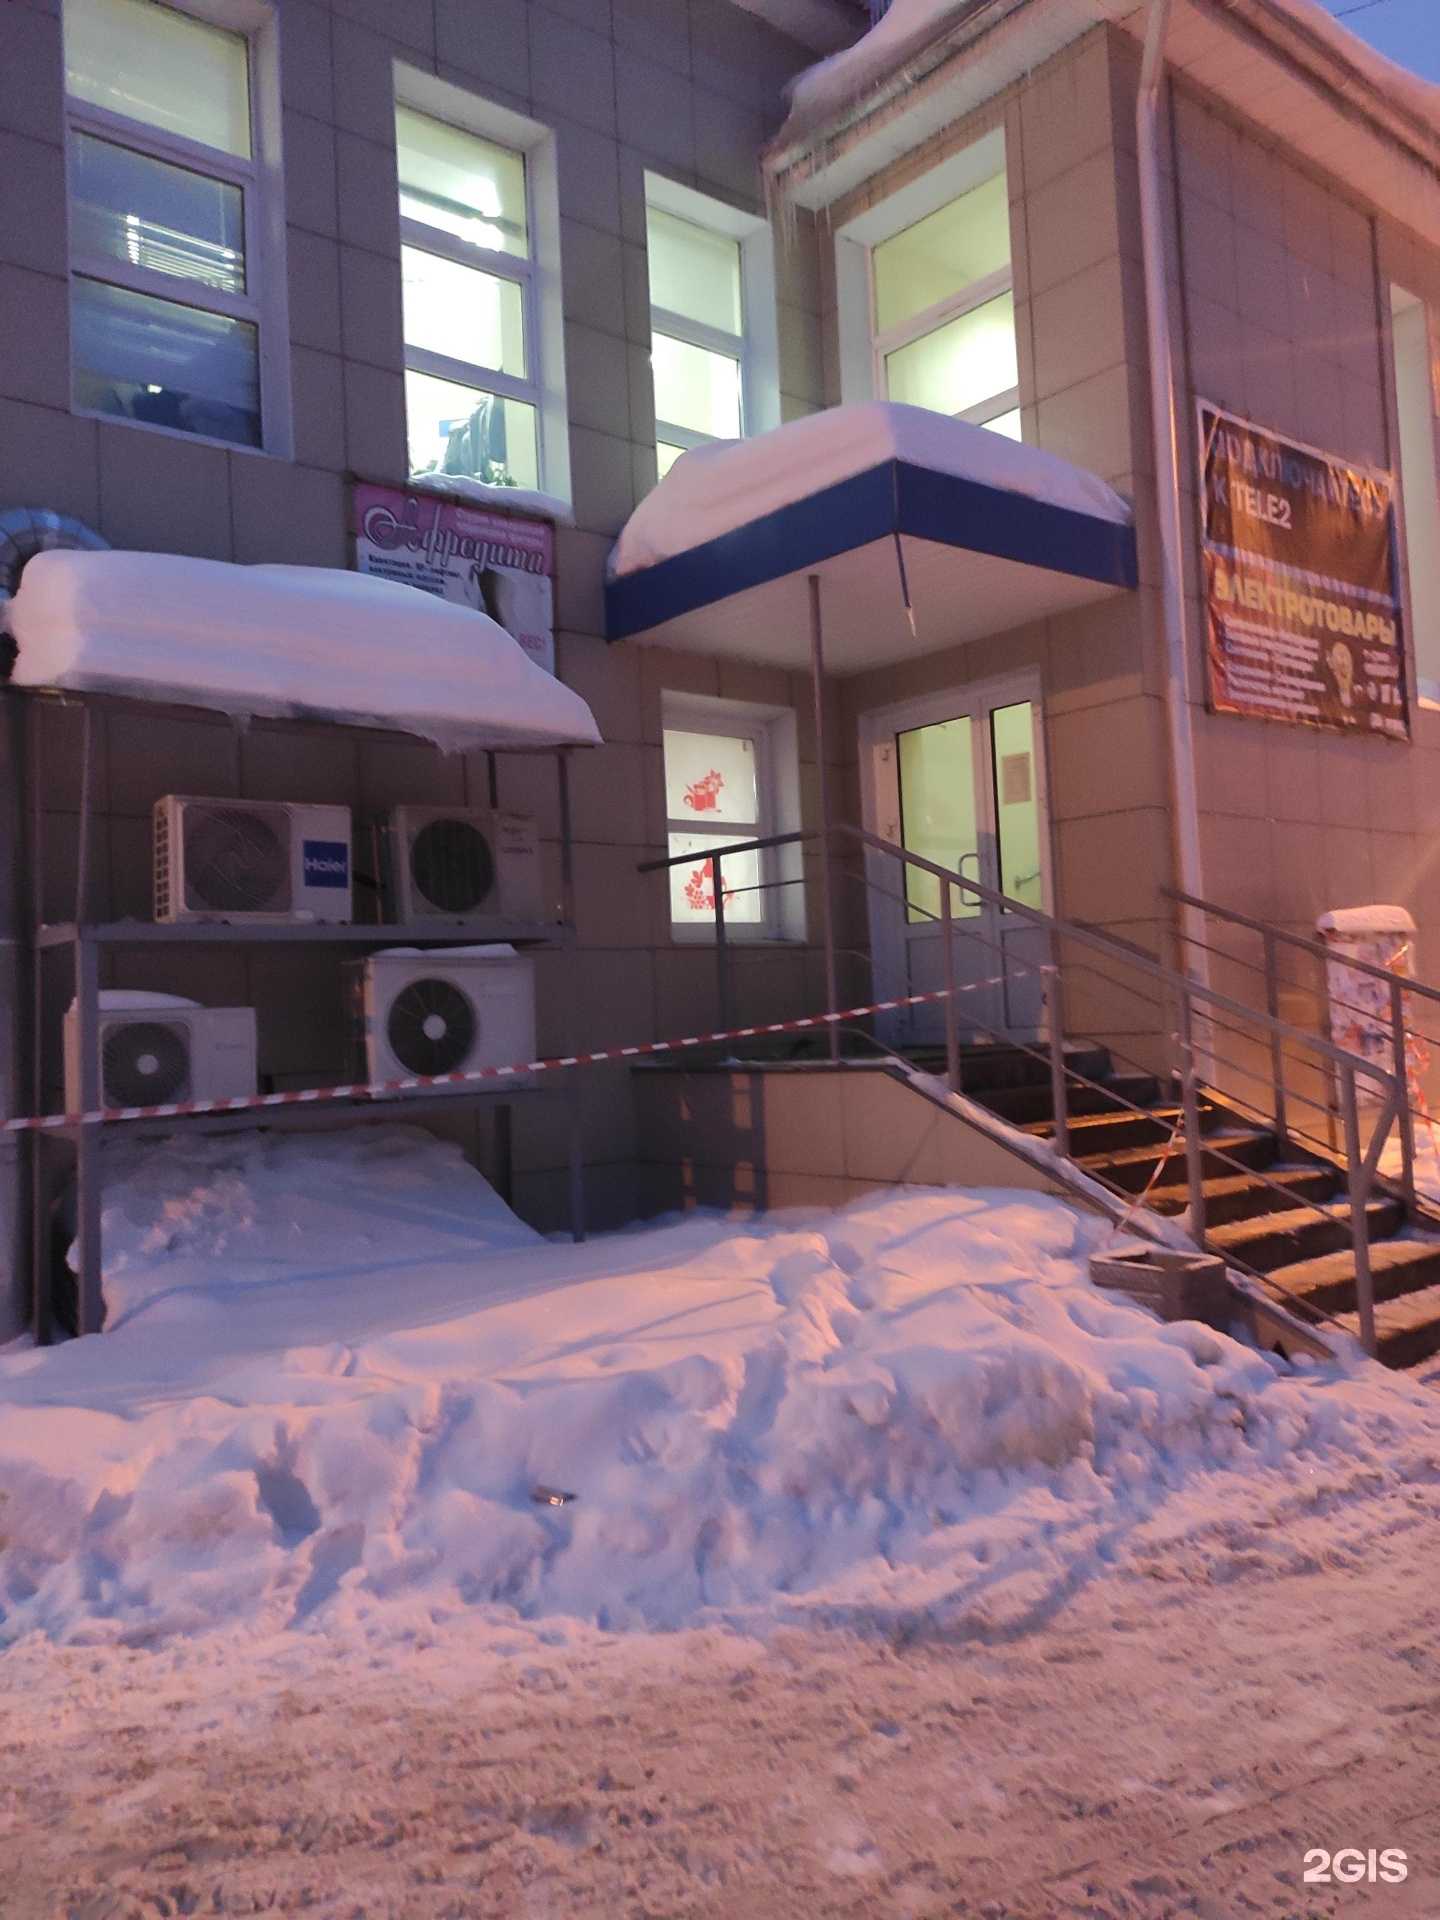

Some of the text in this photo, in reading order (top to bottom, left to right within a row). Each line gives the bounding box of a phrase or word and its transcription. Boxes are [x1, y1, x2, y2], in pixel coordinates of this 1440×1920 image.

[362, 495, 544, 576] Афродита
[1230, 479, 1293, 531] TELE2
[1214, 567, 1397, 647] ЭЛЕКТРОТОВАРЫ
[304, 857, 347, 875] Haier
